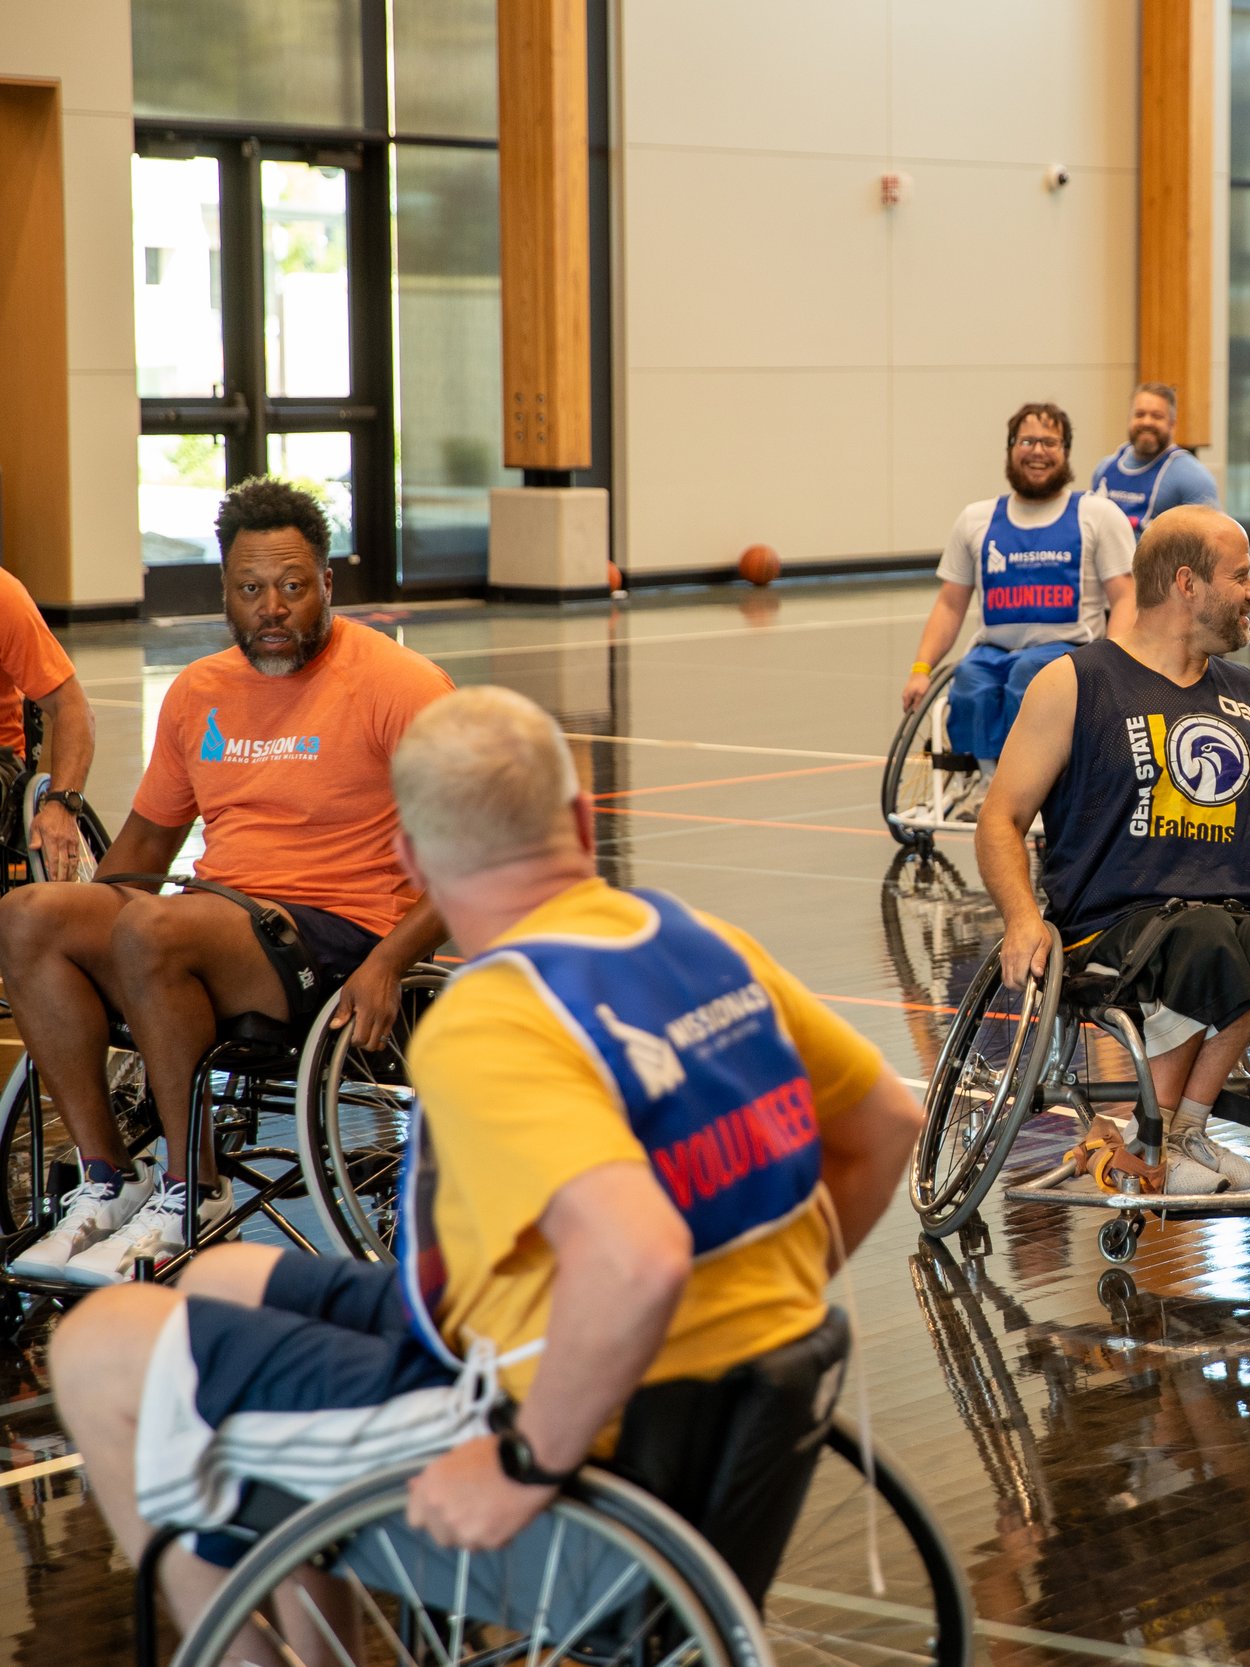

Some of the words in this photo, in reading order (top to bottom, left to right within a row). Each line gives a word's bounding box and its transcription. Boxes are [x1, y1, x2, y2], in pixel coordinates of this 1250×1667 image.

[1008, 550, 1073, 564] MISSION43
[225, 736, 321, 758] MISSION43
[1126, 715, 1155, 781] STATE
[1129, 785, 1152, 837] GEM
[1154, 815, 1236, 843] Falcons
